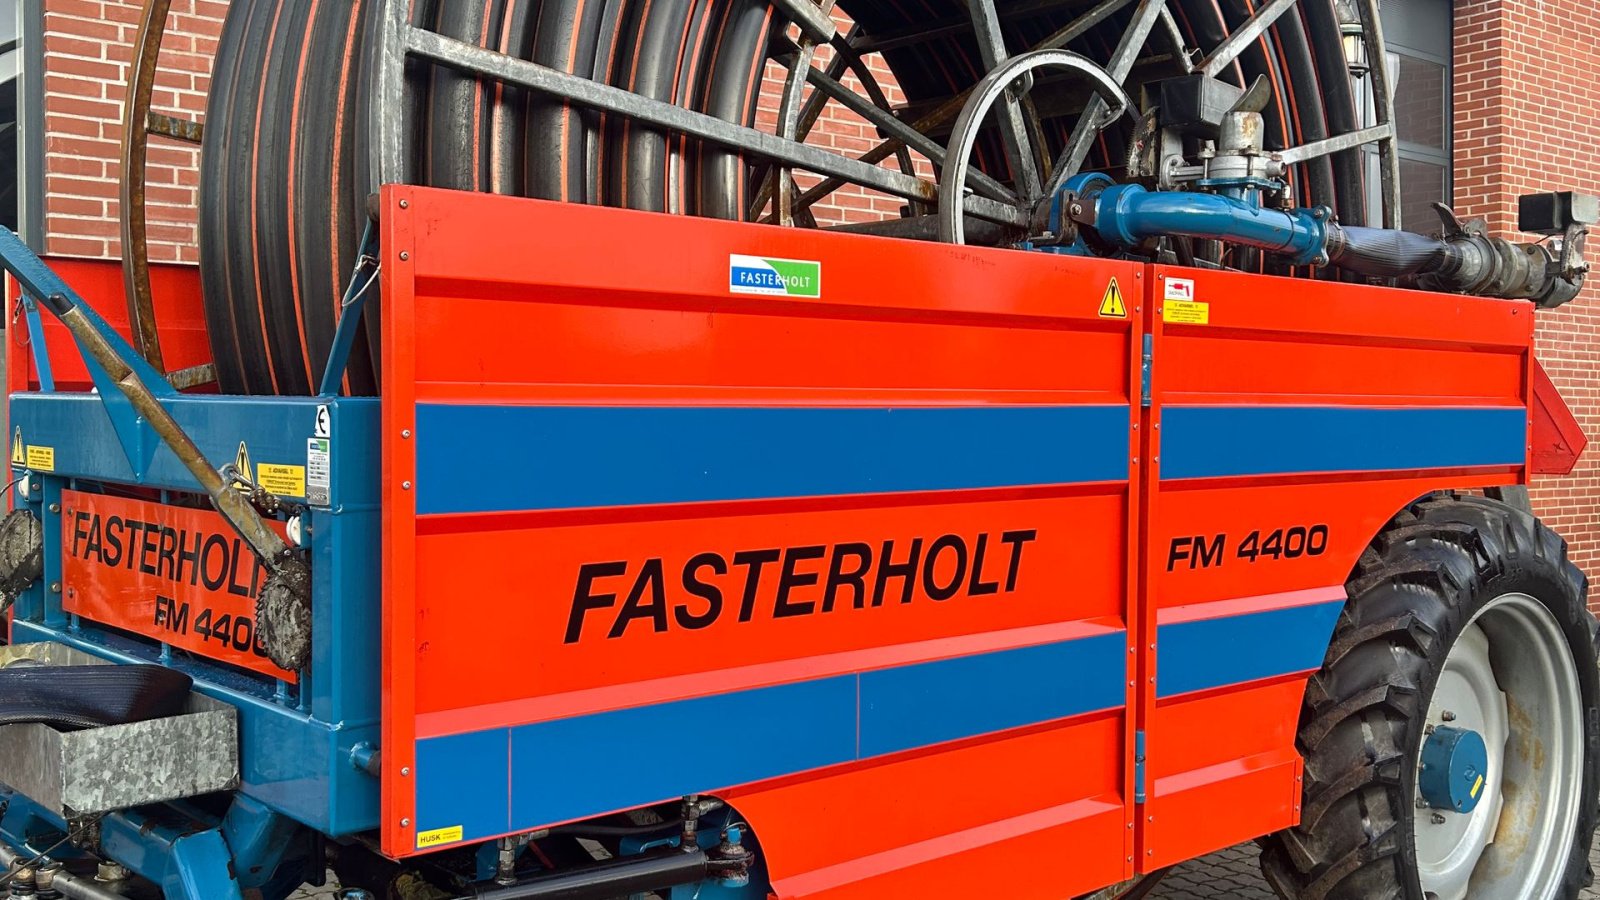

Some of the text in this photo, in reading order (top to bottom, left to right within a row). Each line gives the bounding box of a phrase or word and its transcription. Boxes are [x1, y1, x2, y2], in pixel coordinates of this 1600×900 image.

[740, 271, 811, 288] FASTERHOLT
[1166, 524, 1329, 572] FM 4400
[563, 528, 1038, 645] FASTERHOLT
[154, 595, 190, 636] FM
[420, 833, 441, 844] HUSK
